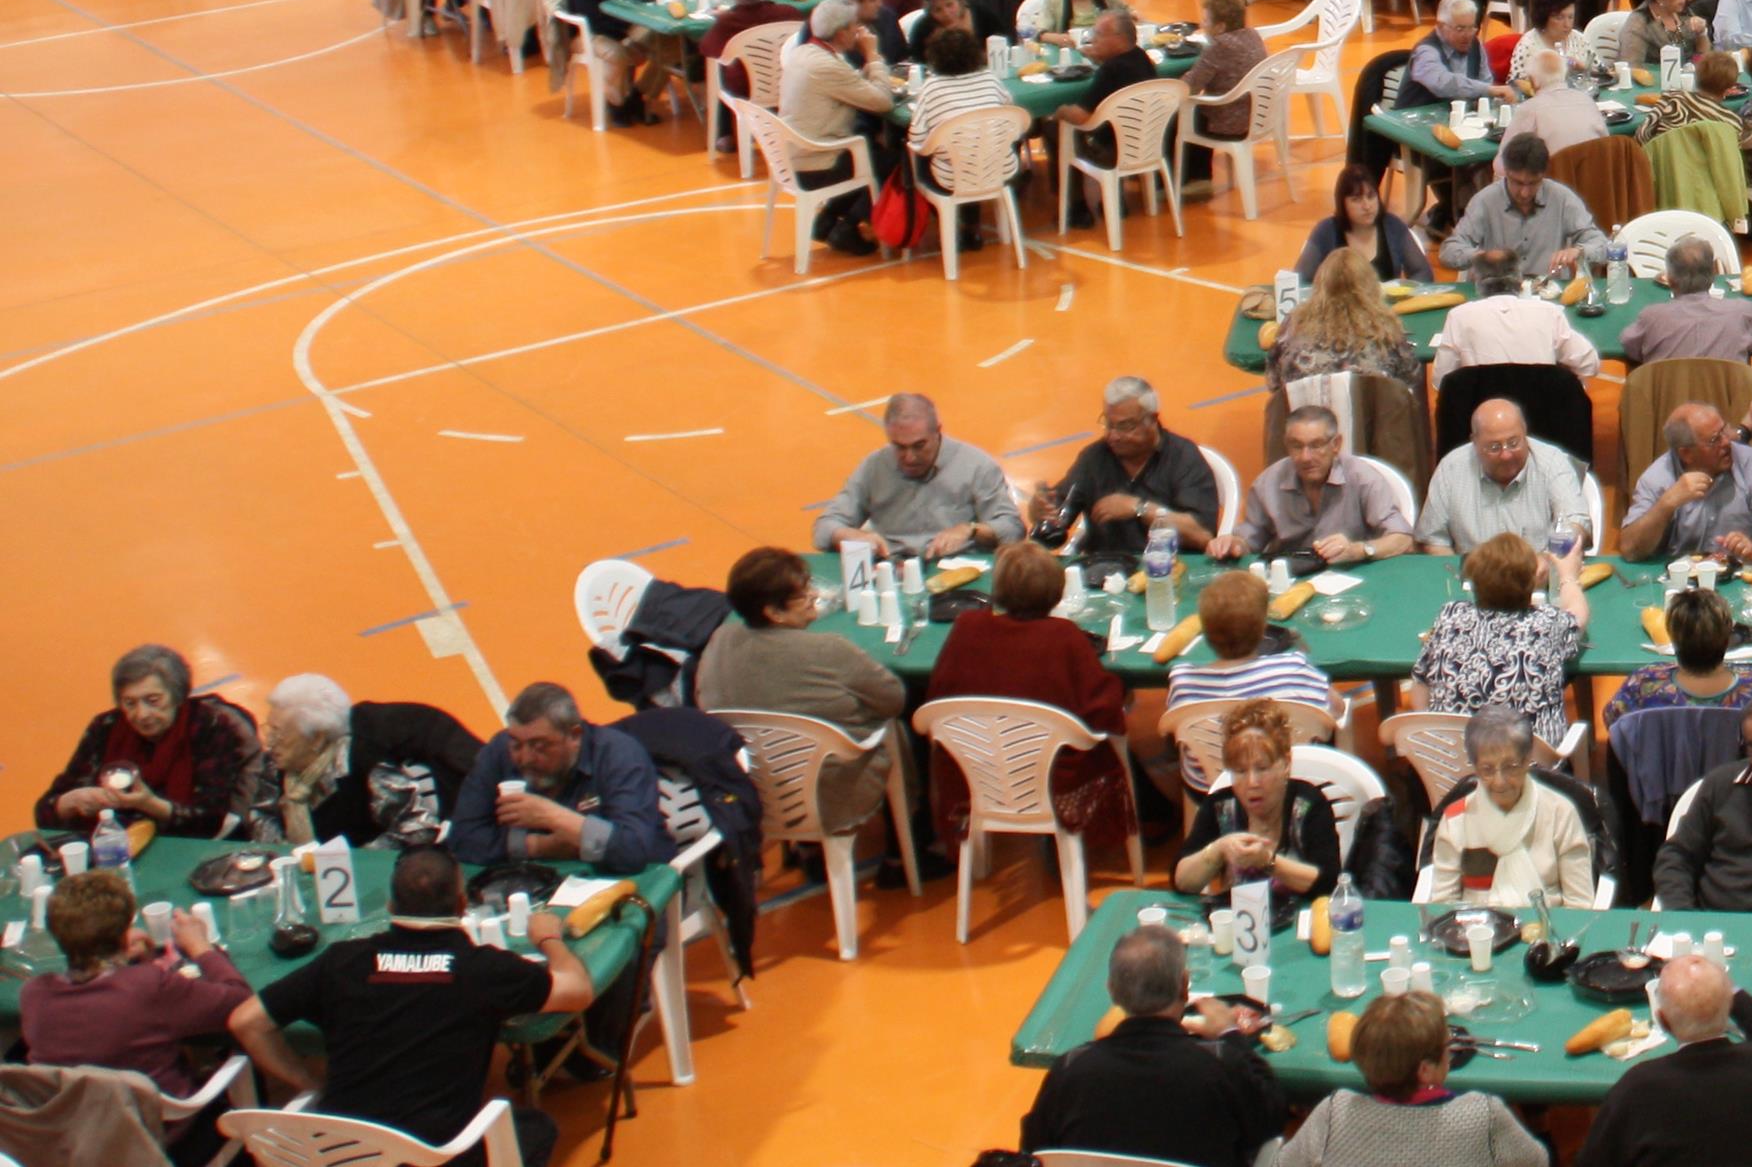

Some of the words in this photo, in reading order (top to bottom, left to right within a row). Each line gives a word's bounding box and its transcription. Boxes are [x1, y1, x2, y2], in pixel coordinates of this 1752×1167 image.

[990, 49, 1005, 71] 11
[1663, 58, 1678, 82] 7
[1279, 287, 1297, 317] 5
[848, 560, 869, 591] 4
[322, 866, 354, 908] 2
[1236, 909, 1258, 953] 3
[376, 952, 453, 973] YAMALUBE
